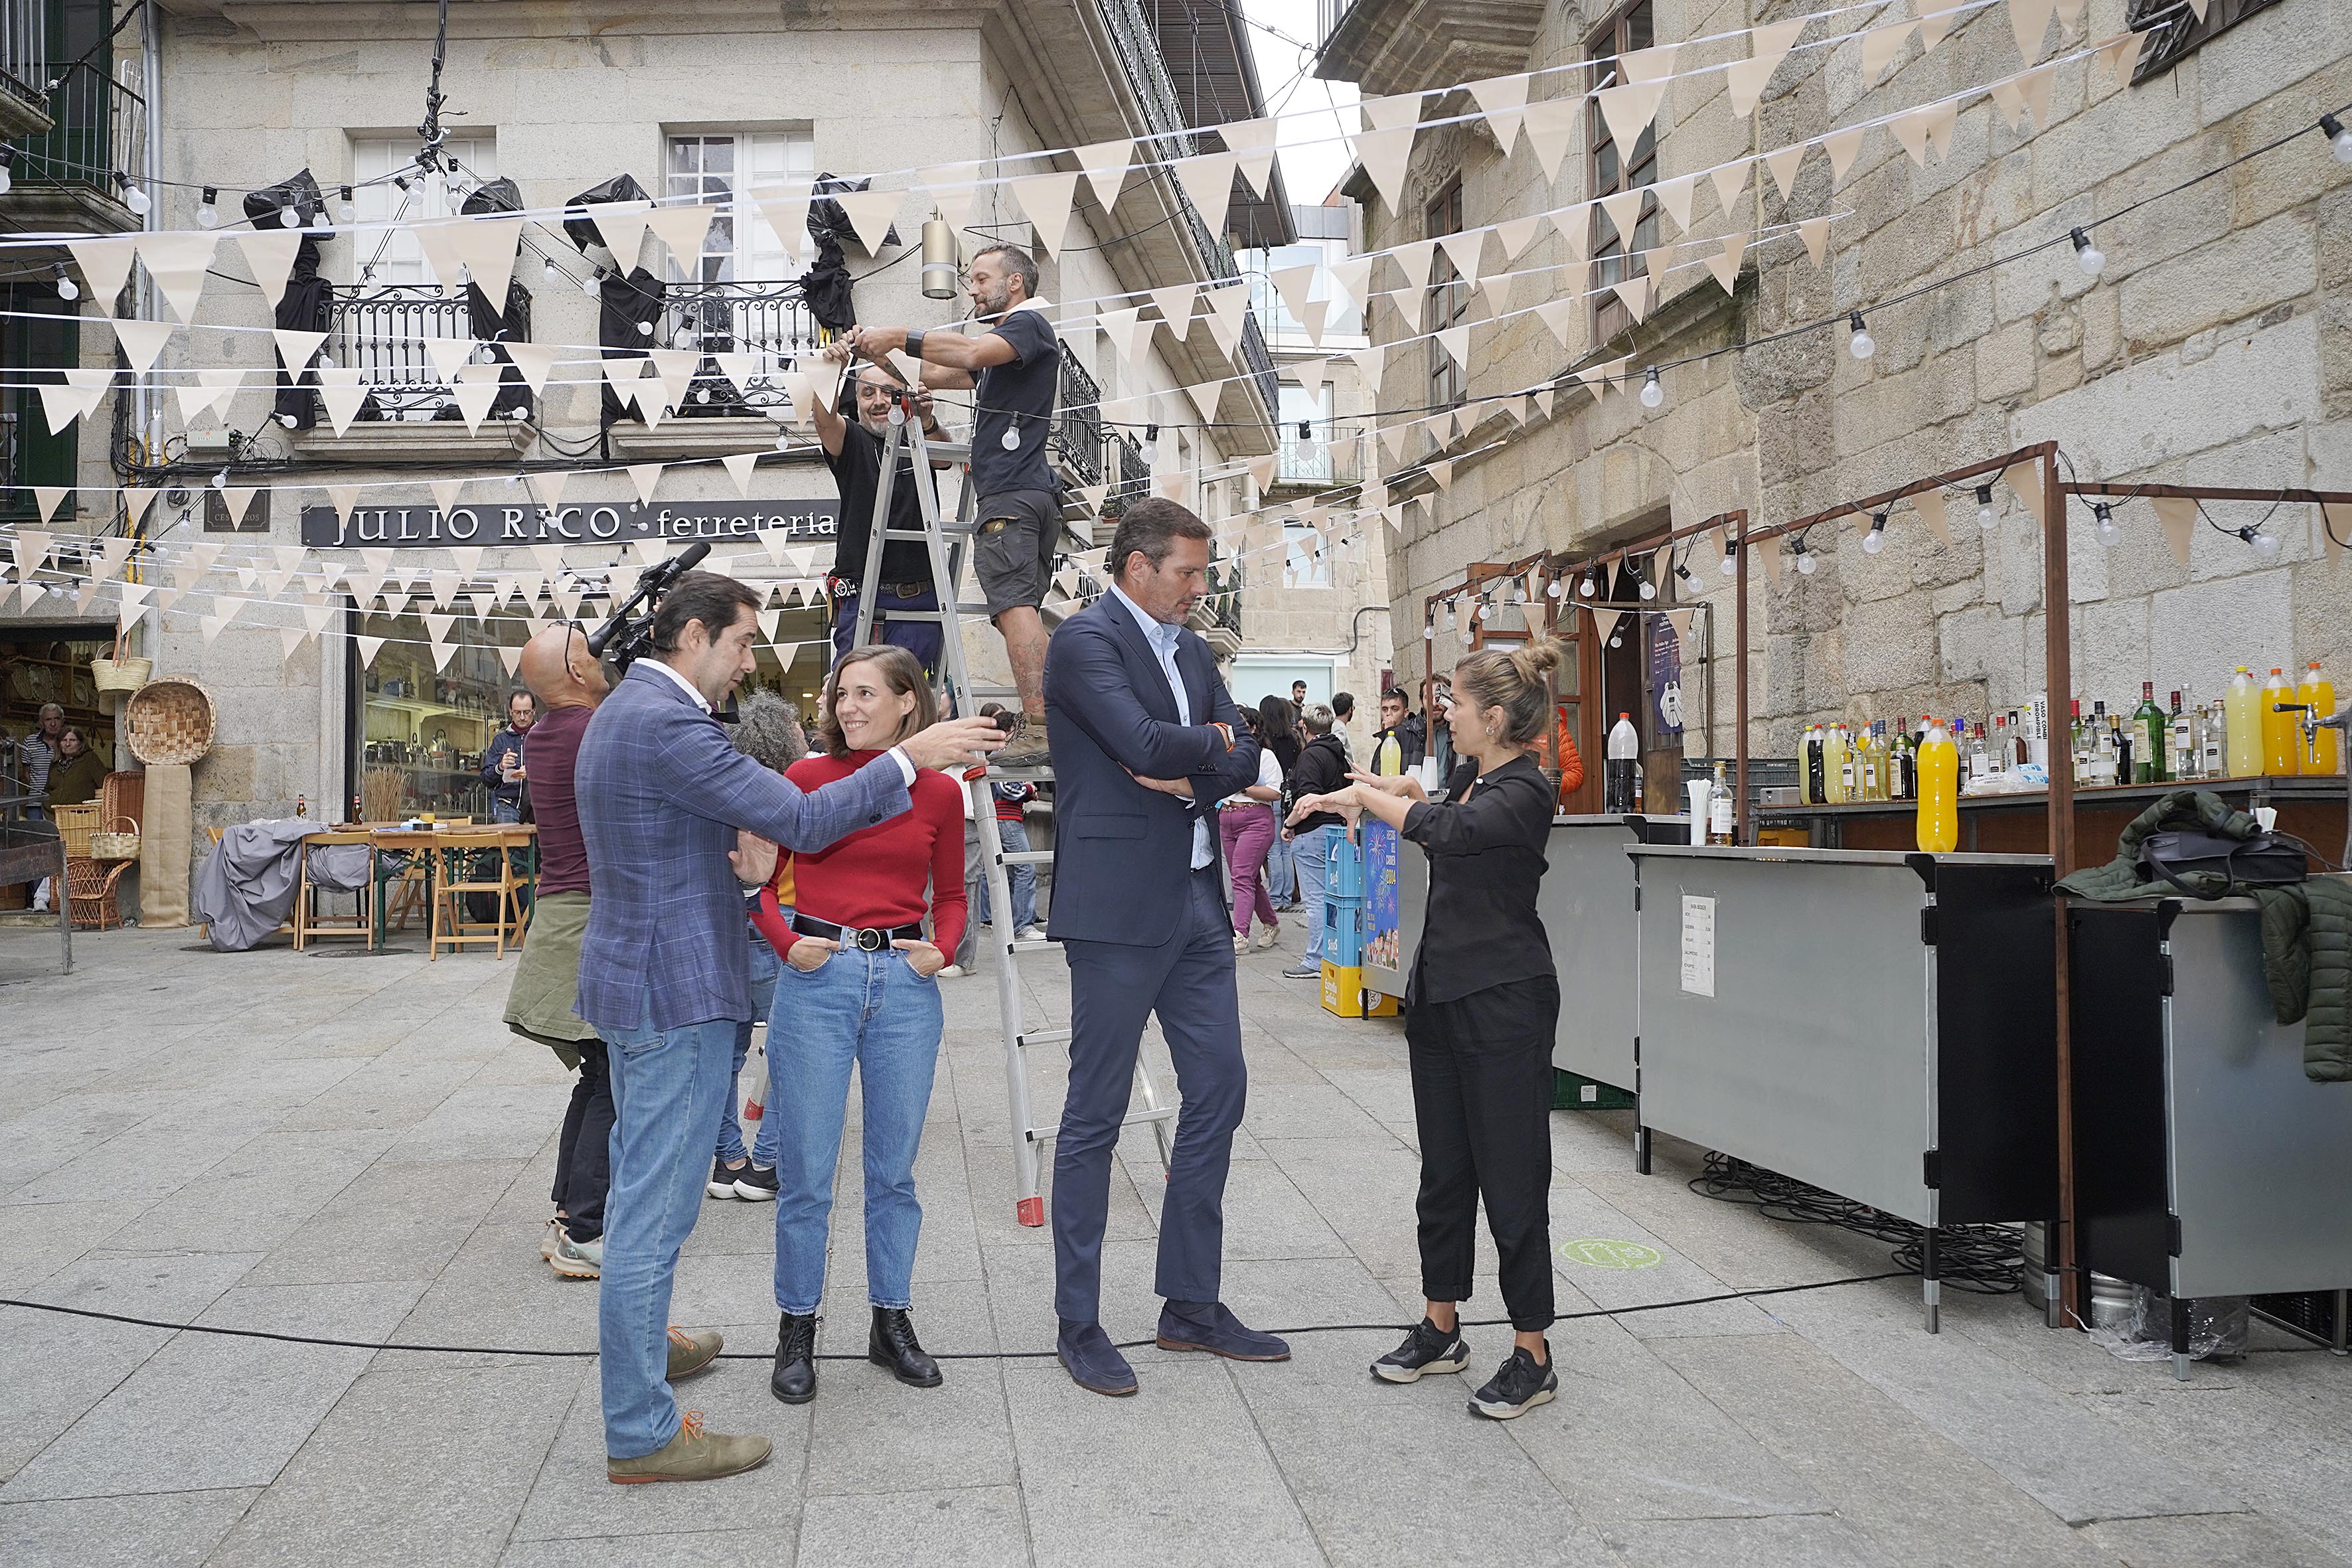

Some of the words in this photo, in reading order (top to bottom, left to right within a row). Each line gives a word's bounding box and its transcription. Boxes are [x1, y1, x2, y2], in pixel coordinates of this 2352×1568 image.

[214, 513, 260, 522] CESROS
[333, 509, 479, 546] JULIO
[501, 506, 621, 539] RICO
